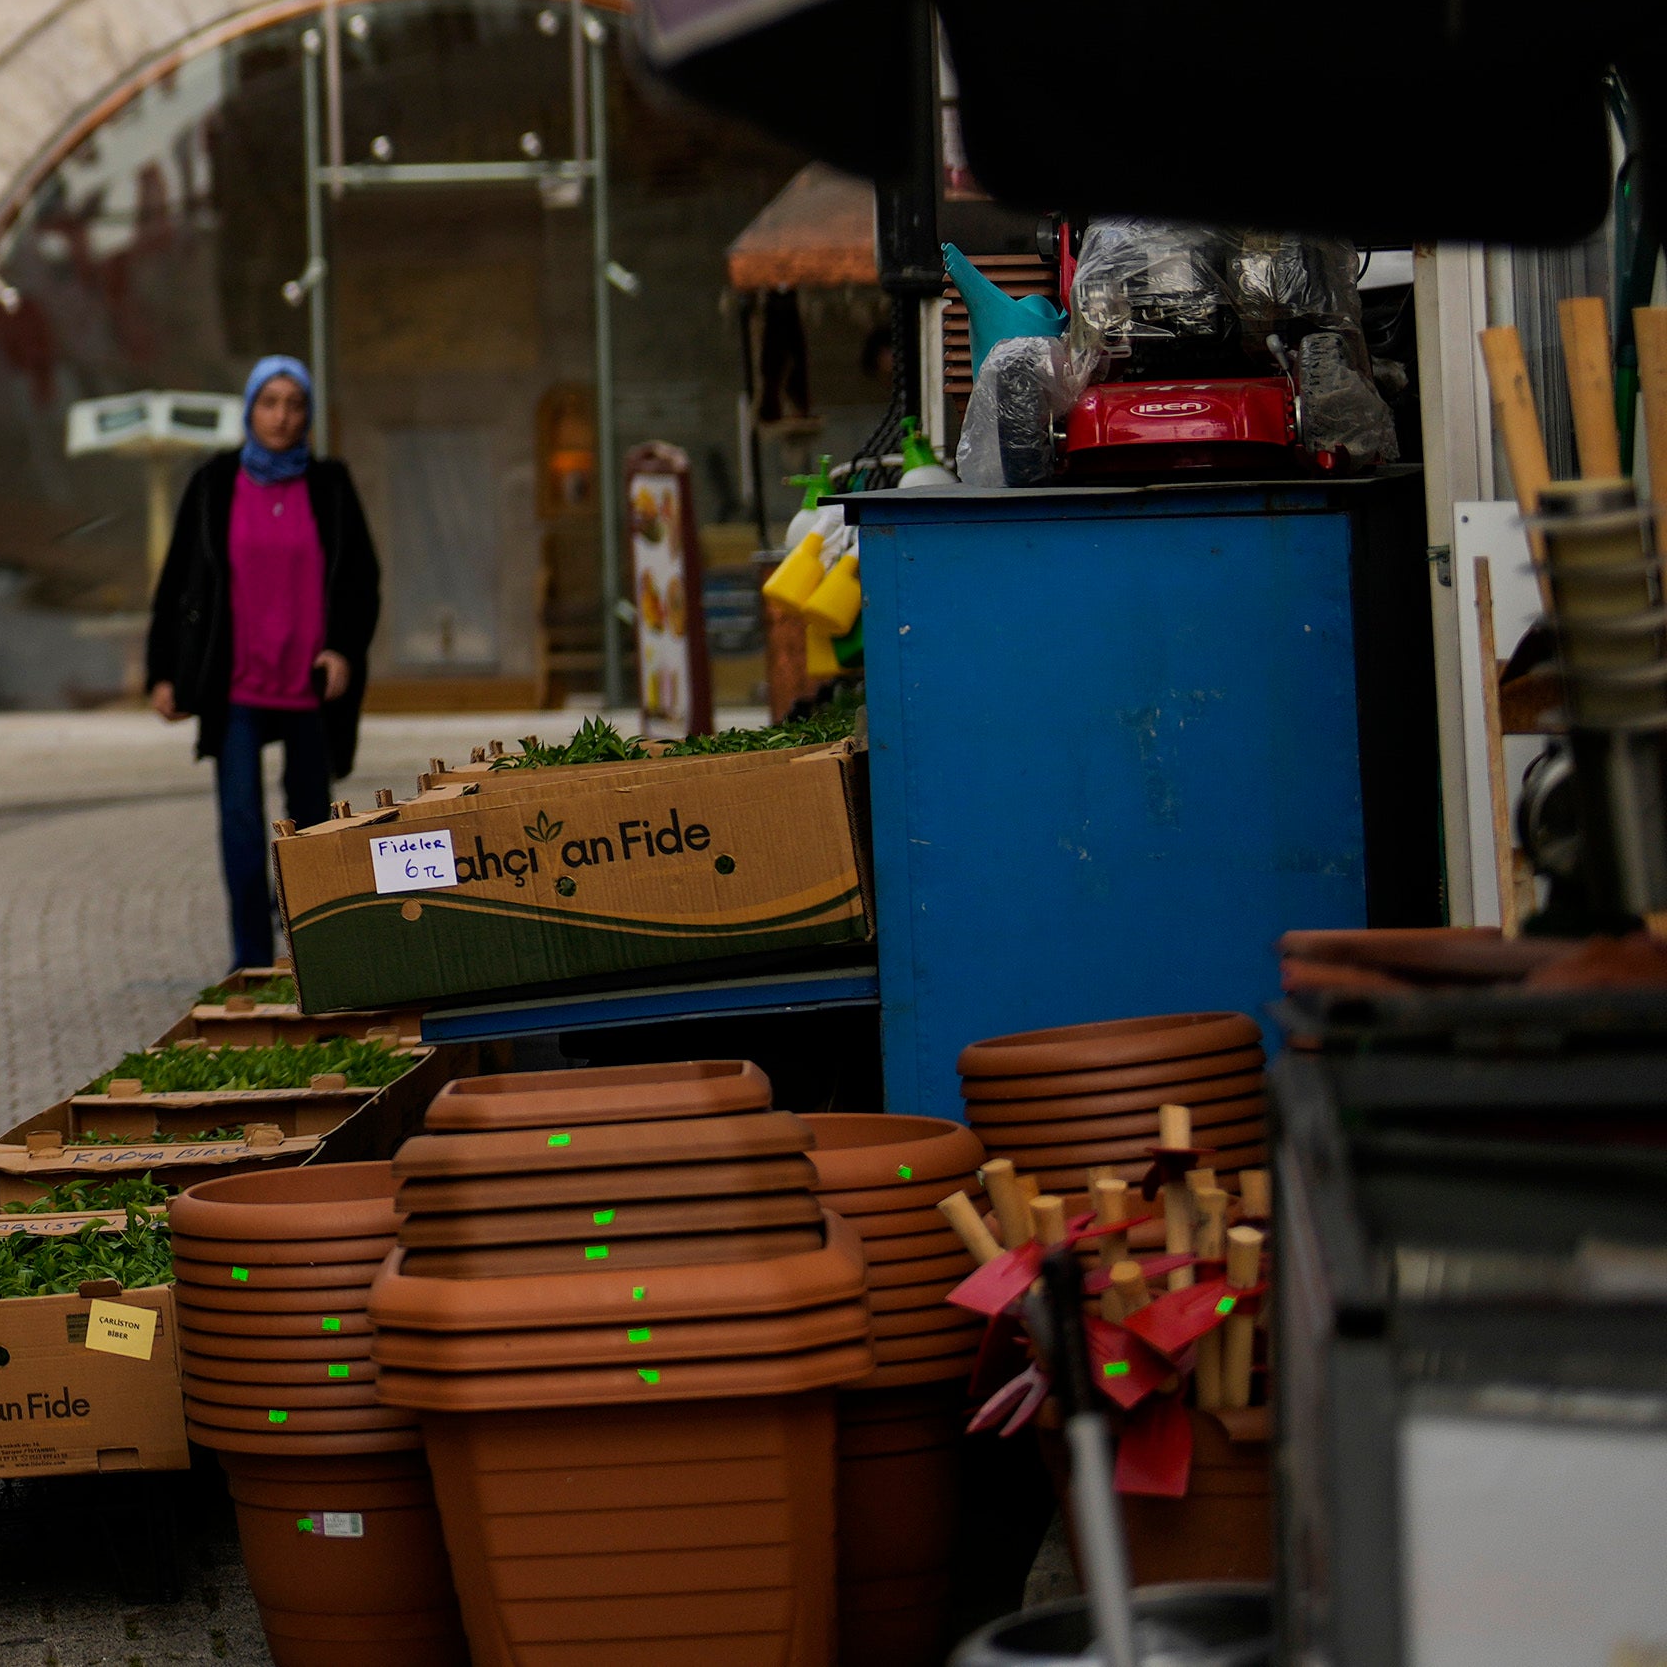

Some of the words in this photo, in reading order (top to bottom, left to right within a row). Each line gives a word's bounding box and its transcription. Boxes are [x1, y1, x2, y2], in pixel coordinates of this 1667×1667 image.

[1139, 402, 1202, 413] IBEA
[619, 808, 711, 860] Fide
[405, 859, 419, 879] 6
[99, 1316, 141, 1331] ÇARLİSTON
[107, 1330, 129, 1340] BİBER
[27, 1386, 90, 1419] Fide
